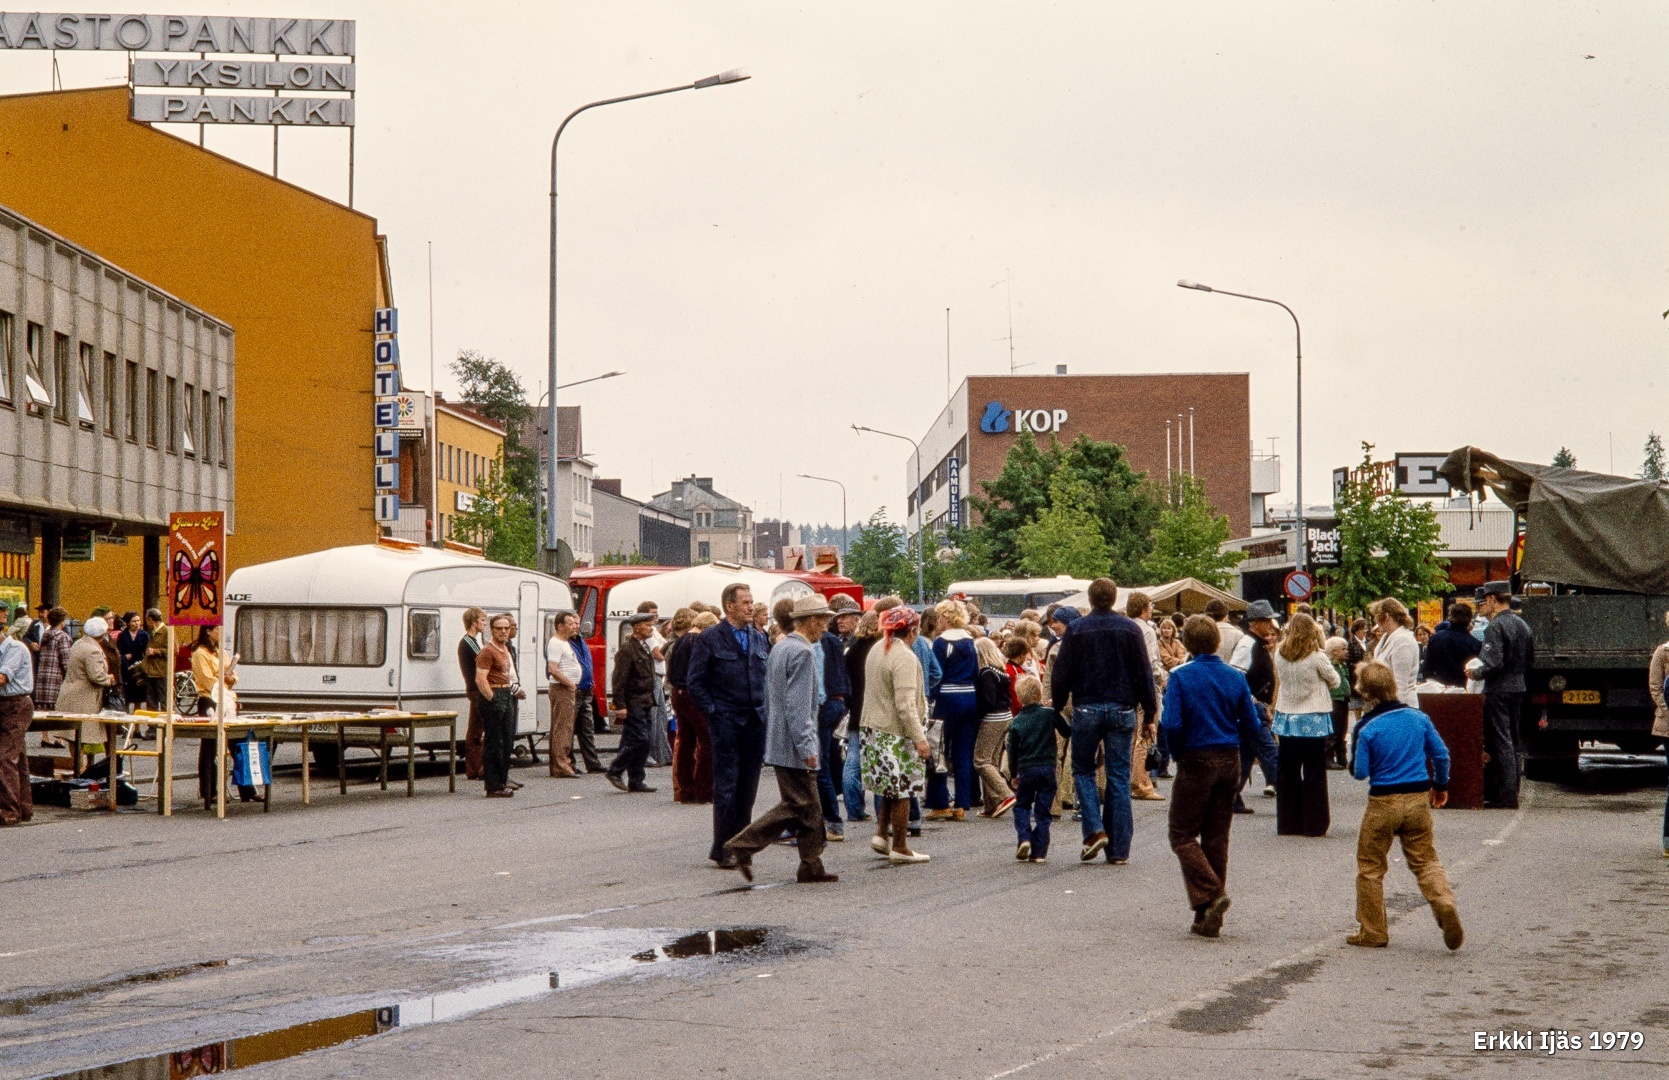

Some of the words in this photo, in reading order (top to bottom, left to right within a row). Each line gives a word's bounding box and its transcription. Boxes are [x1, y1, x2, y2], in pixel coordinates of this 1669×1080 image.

[163, 95, 346, 124] PANKKI
[376, 310, 392, 519] HOTELLI
[1015, 408, 1068, 433] KOP
[950, 459, 959, 529] AAMULEHT
[1308, 528, 1341, 540] Black
[1311, 540, 1338, 552] Jack
[225, 593, 252, 601] ACE
